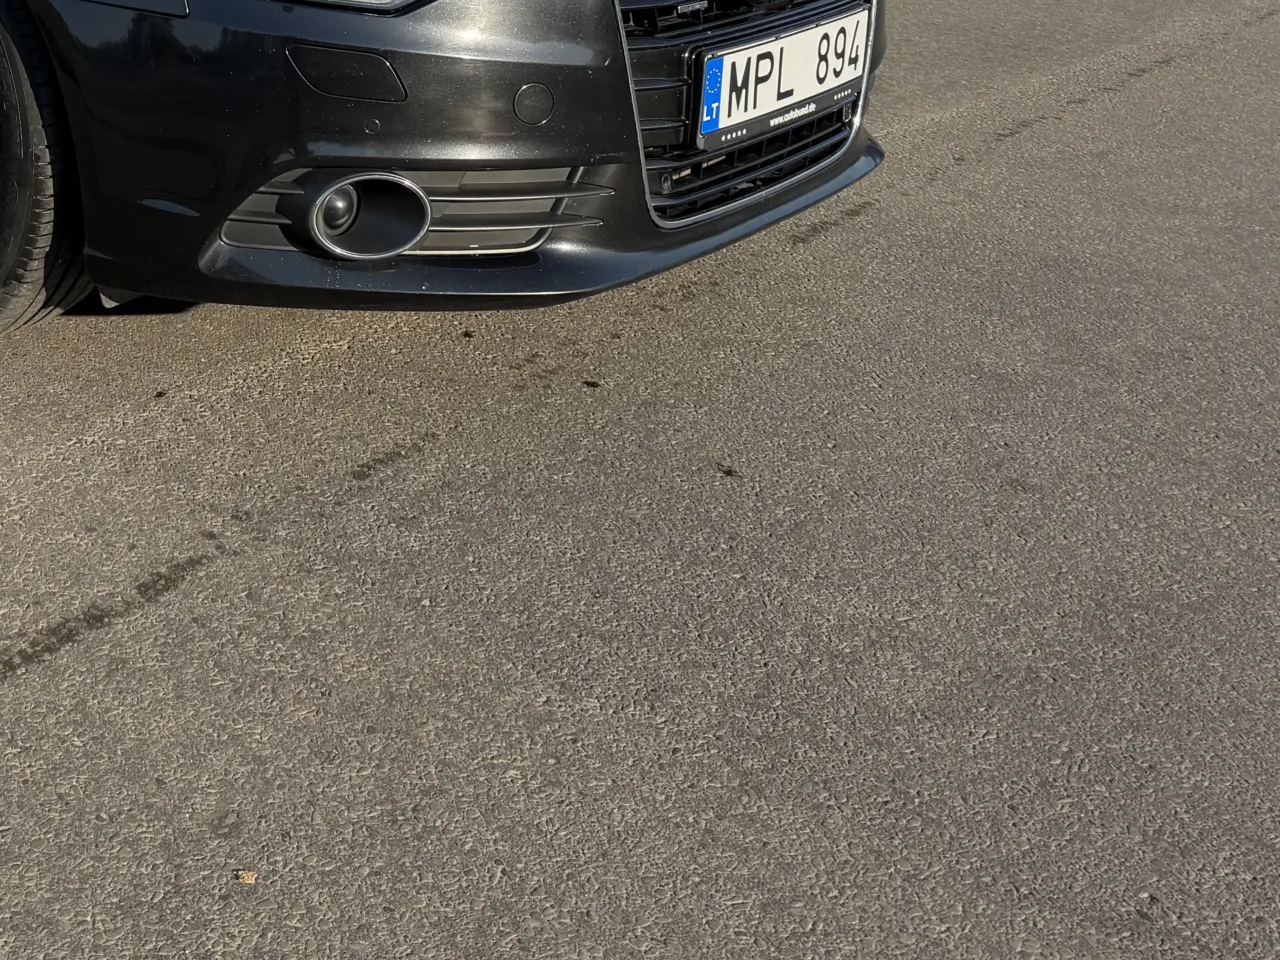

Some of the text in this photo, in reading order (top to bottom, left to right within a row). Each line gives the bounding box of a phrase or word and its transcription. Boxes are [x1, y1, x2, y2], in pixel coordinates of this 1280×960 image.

[727, 20, 860, 118] MPL 894
[702, 102, 719, 122] LT
